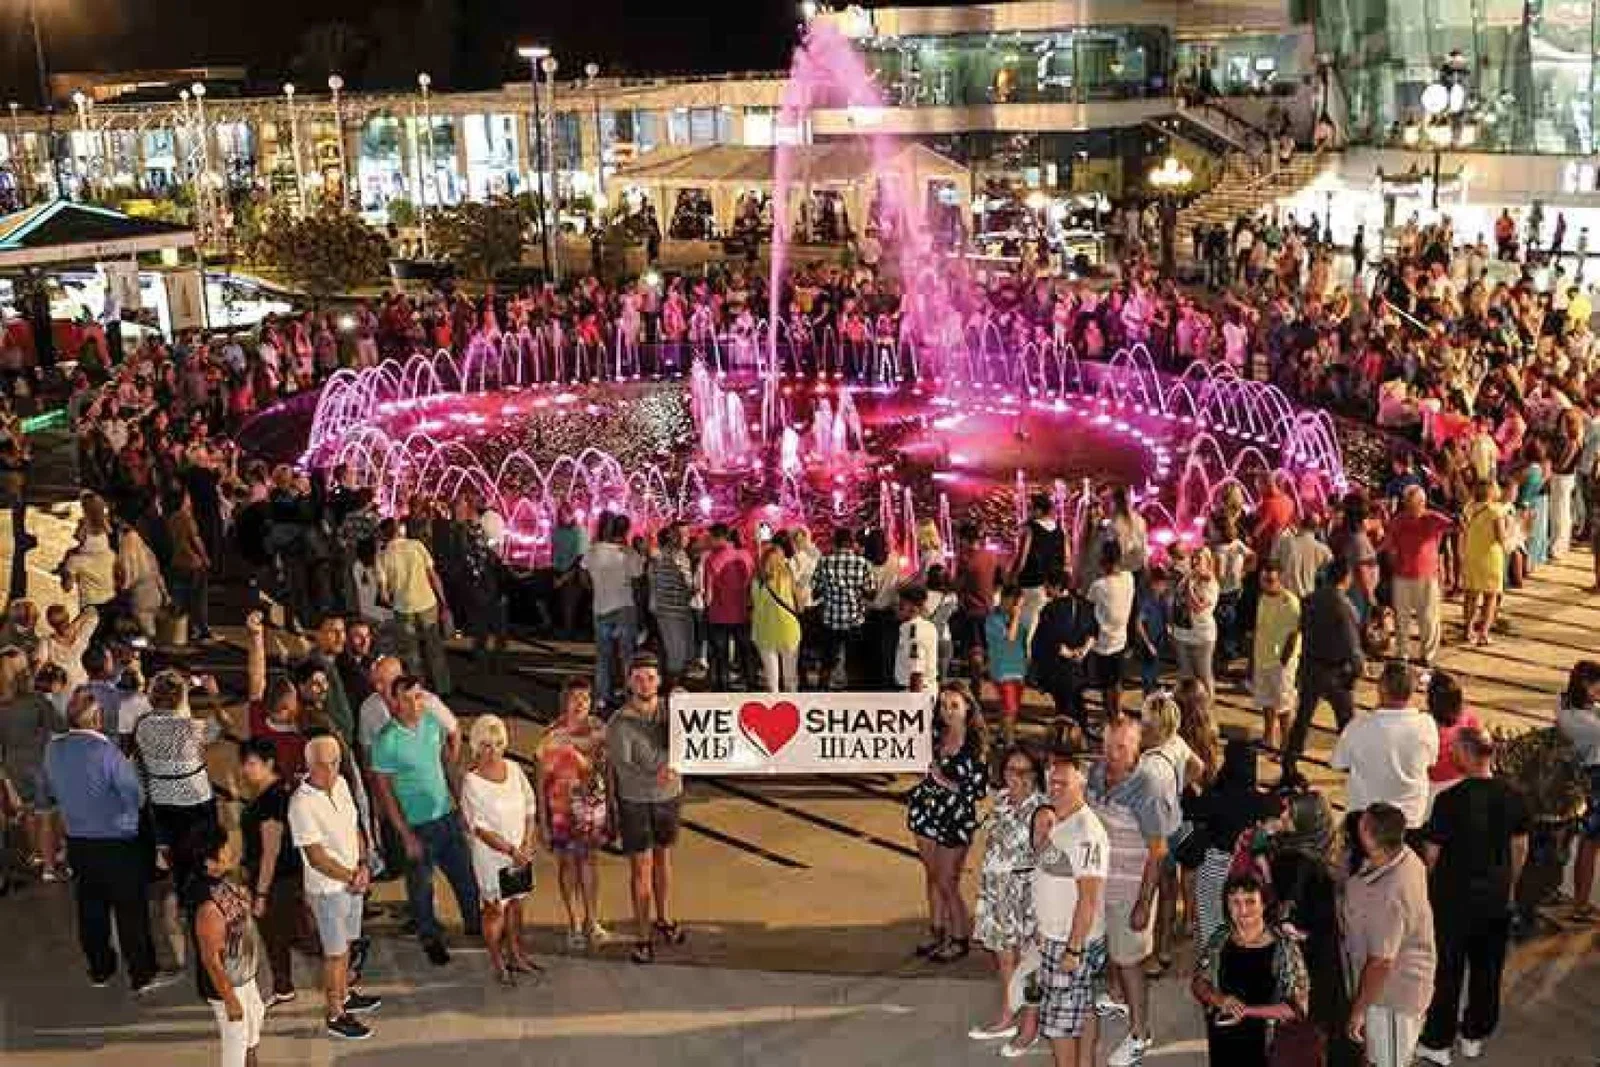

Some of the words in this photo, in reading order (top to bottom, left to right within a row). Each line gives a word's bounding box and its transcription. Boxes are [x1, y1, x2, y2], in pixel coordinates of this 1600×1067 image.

[678, 709, 732, 734] WE
[806, 709, 924, 733] SHARM
[818, 737, 915, 760] ШАРМ
